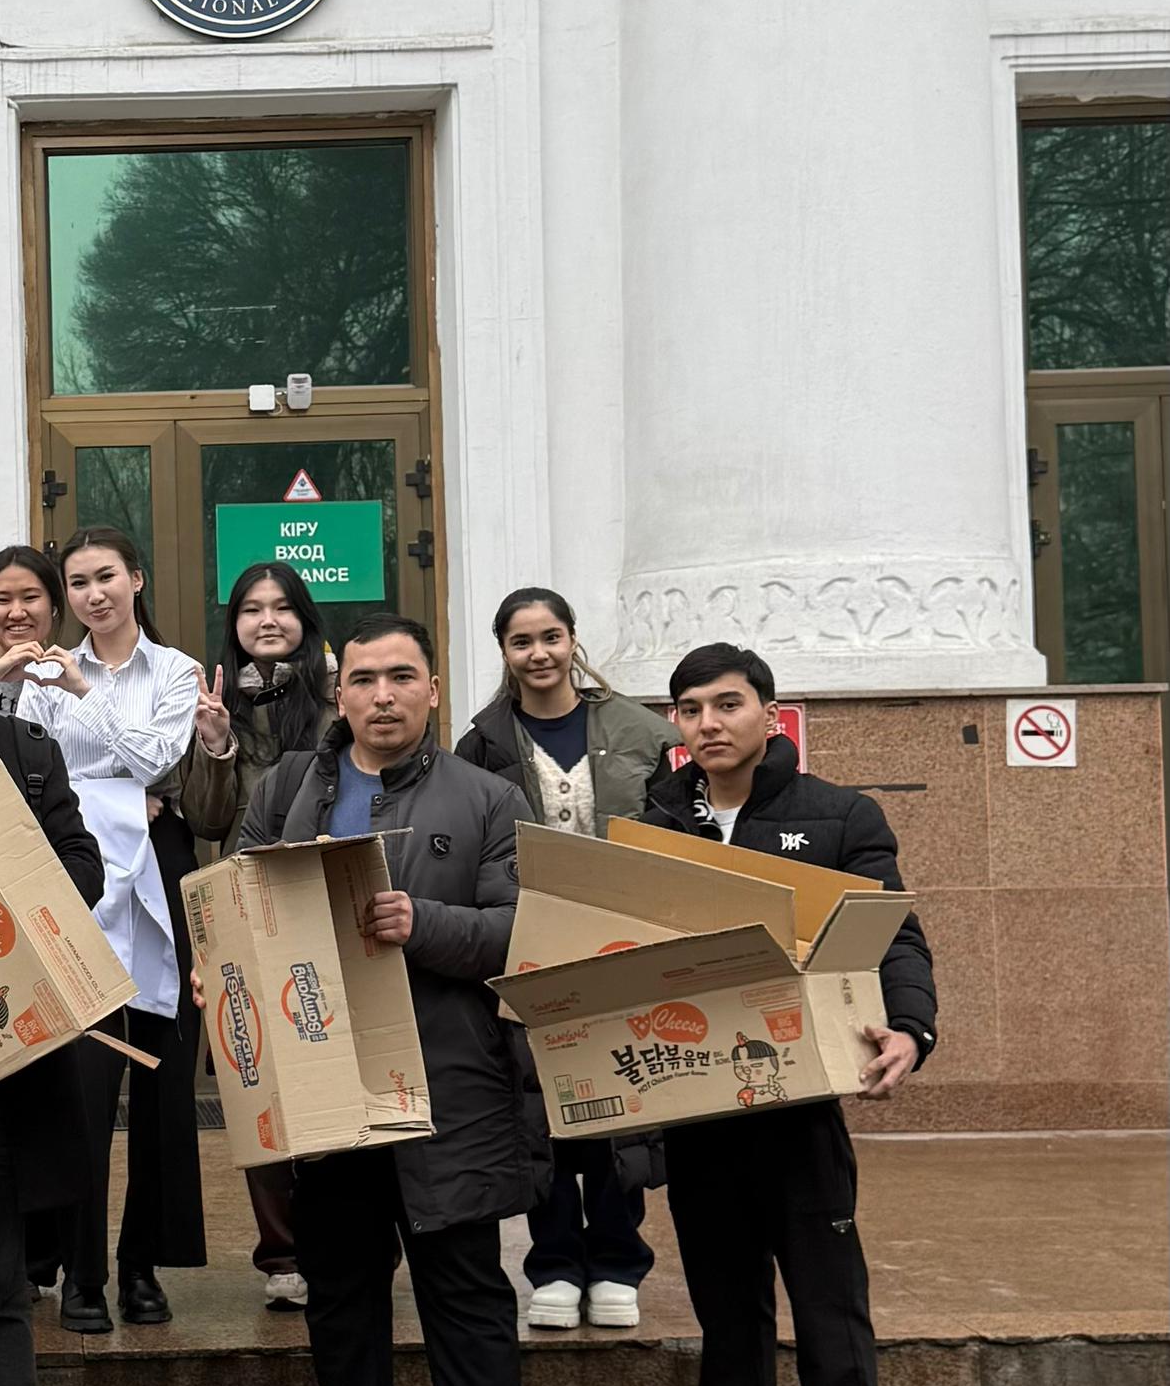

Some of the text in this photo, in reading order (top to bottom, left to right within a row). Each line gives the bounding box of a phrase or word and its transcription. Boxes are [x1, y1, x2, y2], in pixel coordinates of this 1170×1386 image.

[280, 521, 319, 537] КІРУ
[275, 544, 325, 562] ВХОД
[299, 567, 350, 583] ANCE
[779, 832, 811, 851] DIOR
[291, 965, 323, 1033] Samyang
[226, 975, 259, 1083] Samyang
[653, 1008, 705, 1035] Cheese
[544, 1029, 589, 1046] SAMYANG
[773, 1027, 800, 1040] BOWL
[610, 1043, 711, 1085] 불닭볶음면
